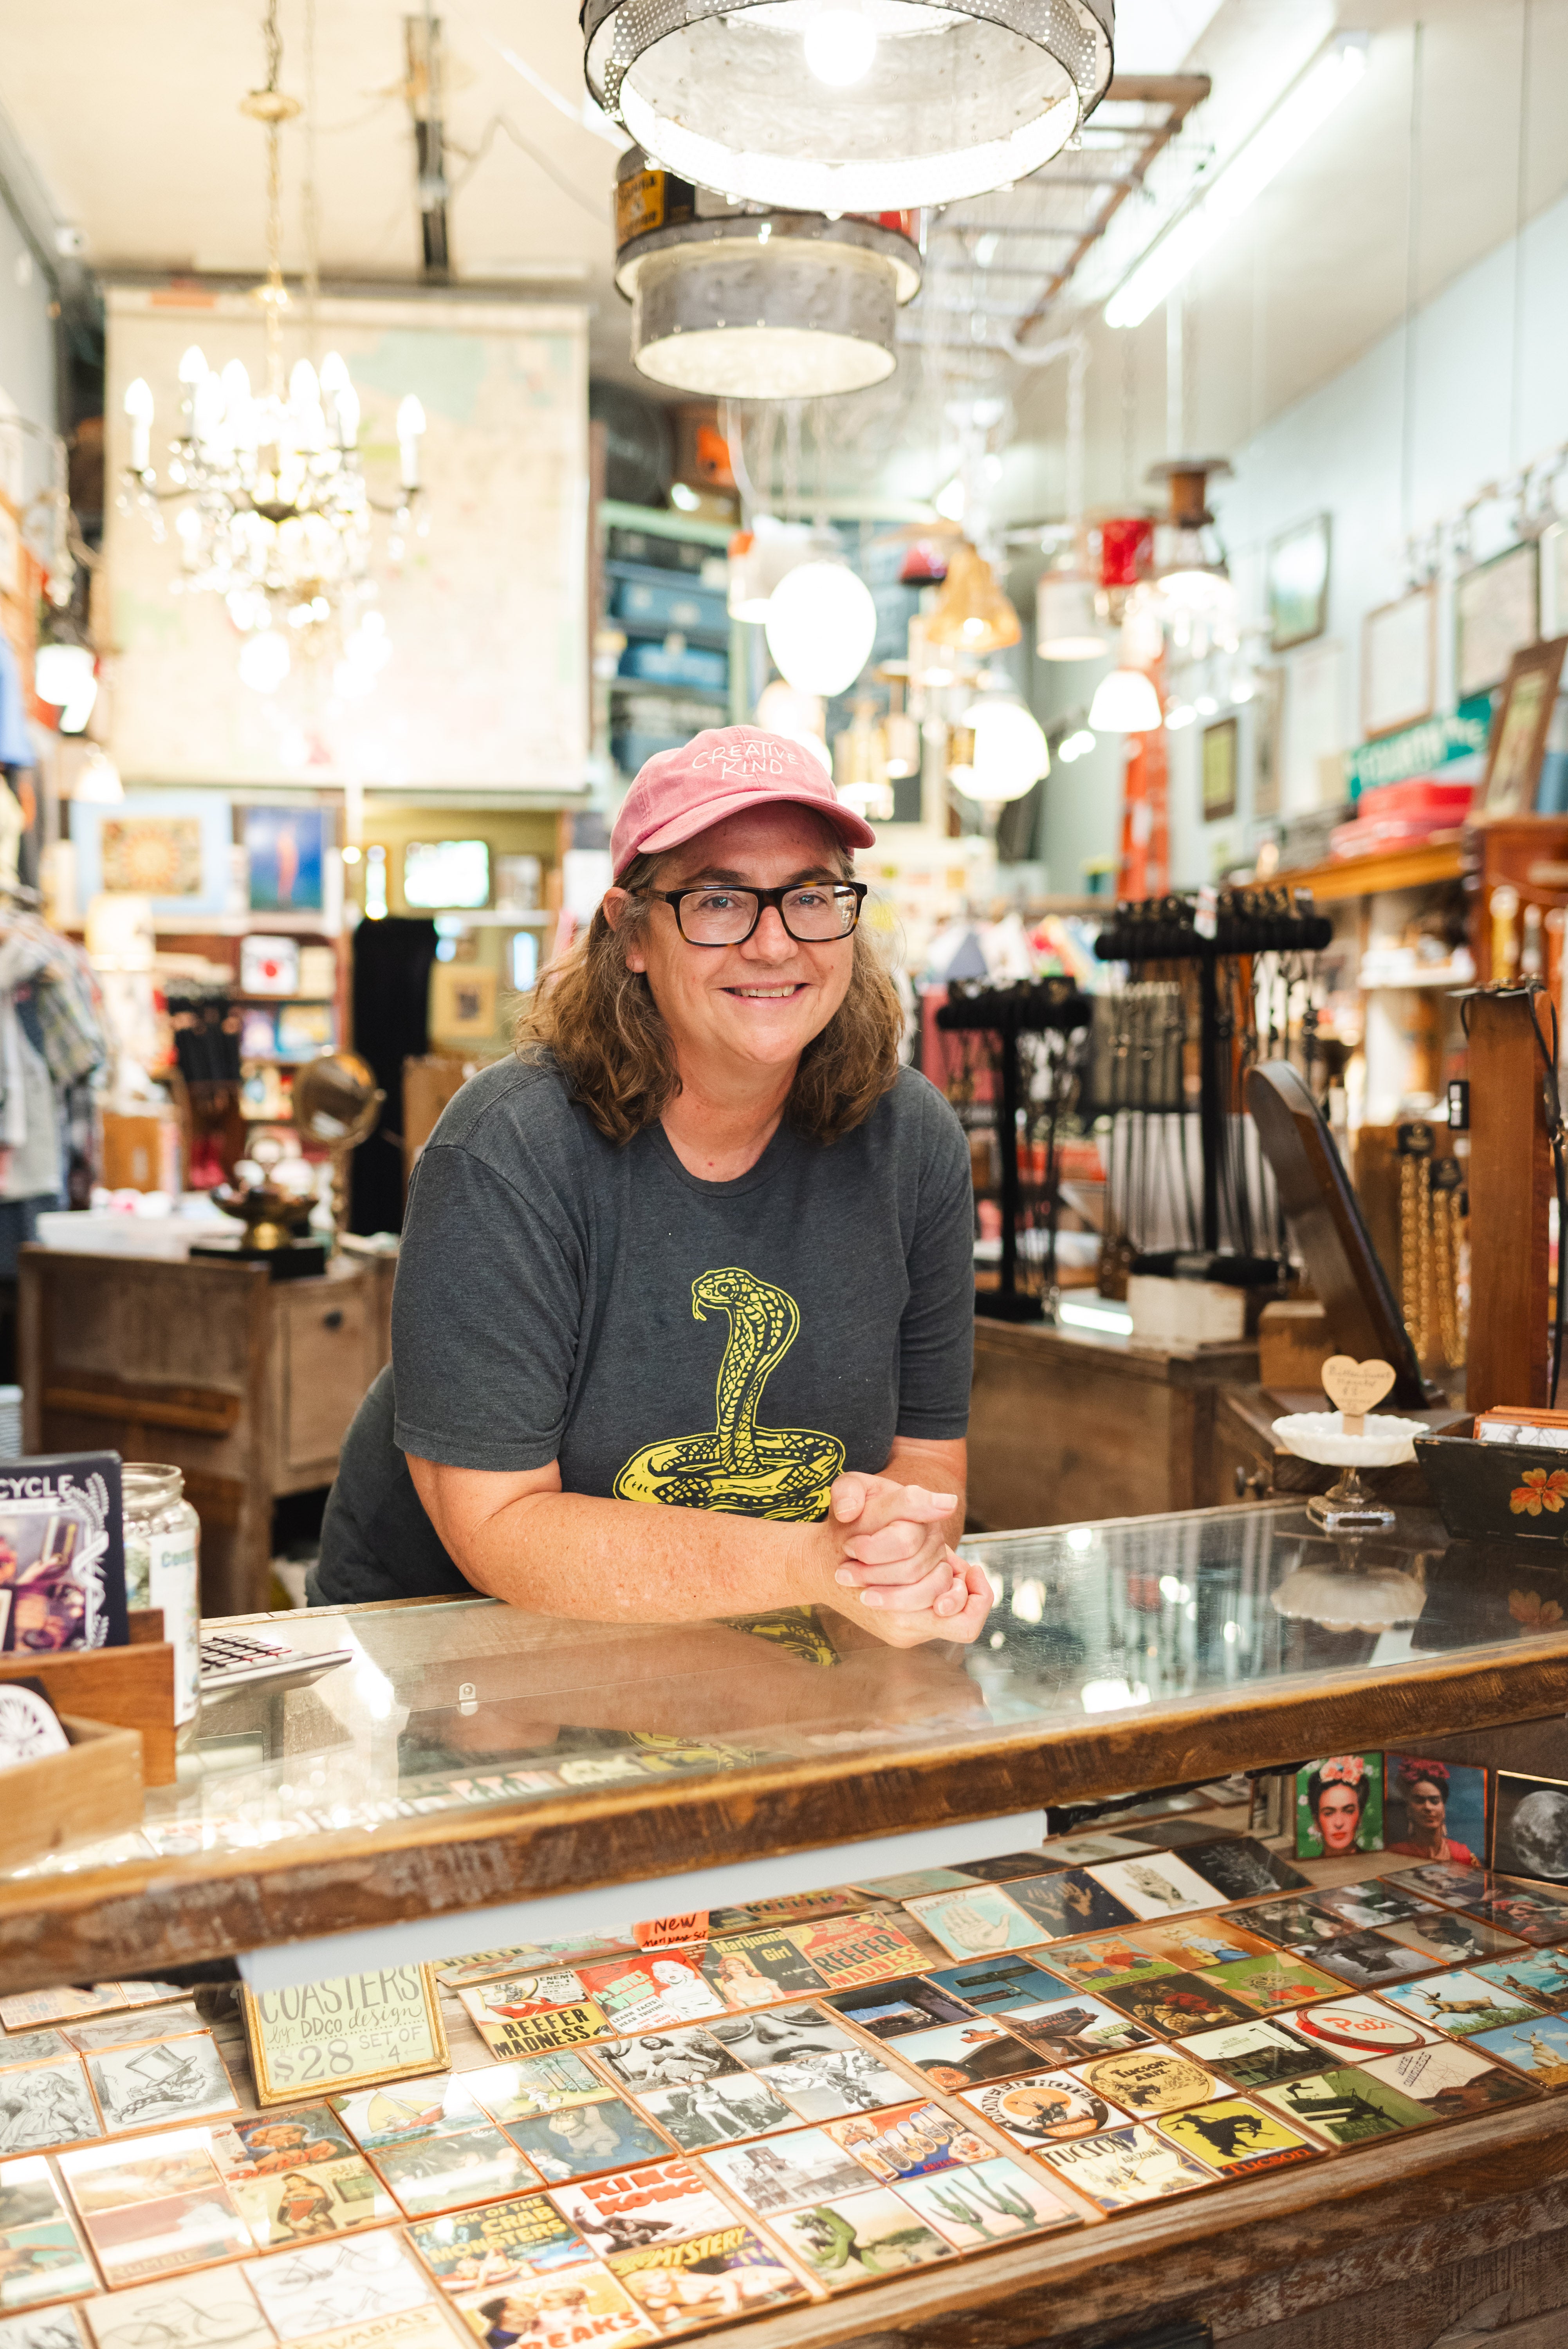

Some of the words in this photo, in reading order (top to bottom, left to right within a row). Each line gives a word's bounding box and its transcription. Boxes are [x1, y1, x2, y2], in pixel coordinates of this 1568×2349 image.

[692, 740, 799, 769] CREATIVE
[721, 760, 783, 780] KIND
[653, 1912, 697, 1934] New
[711, 1931, 784, 1953] Marijuana
[761, 1945, 793, 1961] Girl
[812, 1933, 906, 1975] REEFER
[829, 1944, 924, 1986] MADNESS
[258, 1964, 420, 2024] COASTERS
[267, 2025, 296, 2044] by
[349, 2004, 422, 2030] design
[502, 2008, 591, 2039] REEFER
[612, 2011, 635, 2023] LEARN
[637, 1999, 659, 2012] FACTS!
[618, 2017, 638, 2027] HEAR
[639, 2003, 666, 2017] TRUTHS!
[654, 2014, 671, 2024] WHO
[1321, 2017, 1395, 2032] Pat's
[359, 2030, 390, 2049] SET
[399, 2026, 423, 2042] OF
[493, 2025, 591, 2058] MADNESS
[274, 2039, 354, 2082] $28
[388, 2044, 401, 2063] 4
[1135, 2068, 1172, 2082] ARIZ.
[982, 2080, 1026, 2123] PIONEER
[1034, 2079, 1097, 2103] HOTEL
[1052, 2121, 1092, 2133] TUCSON
[848, 2102, 965, 2182] TUCSON
[1037, 2134, 1135, 2168] TUCSON
[1120, 2147, 1166, 2164] ARIZONA
[1222, 2148, 1312, 2176] Tucson
[580, 2163, 695, 2200] KING
[594, 2178, 706, 2216] KONG
[414, 2212, 482, 2235] ATCK
[485, 2206, 508, 2218] OF
[509, 2197, 545, 2212] THE
[480, 2205, 556, 2234] CRAB
[428, 2218, 567, 2264] MONSTERS
[644, 2226, 747, 2269] MYSTERY
